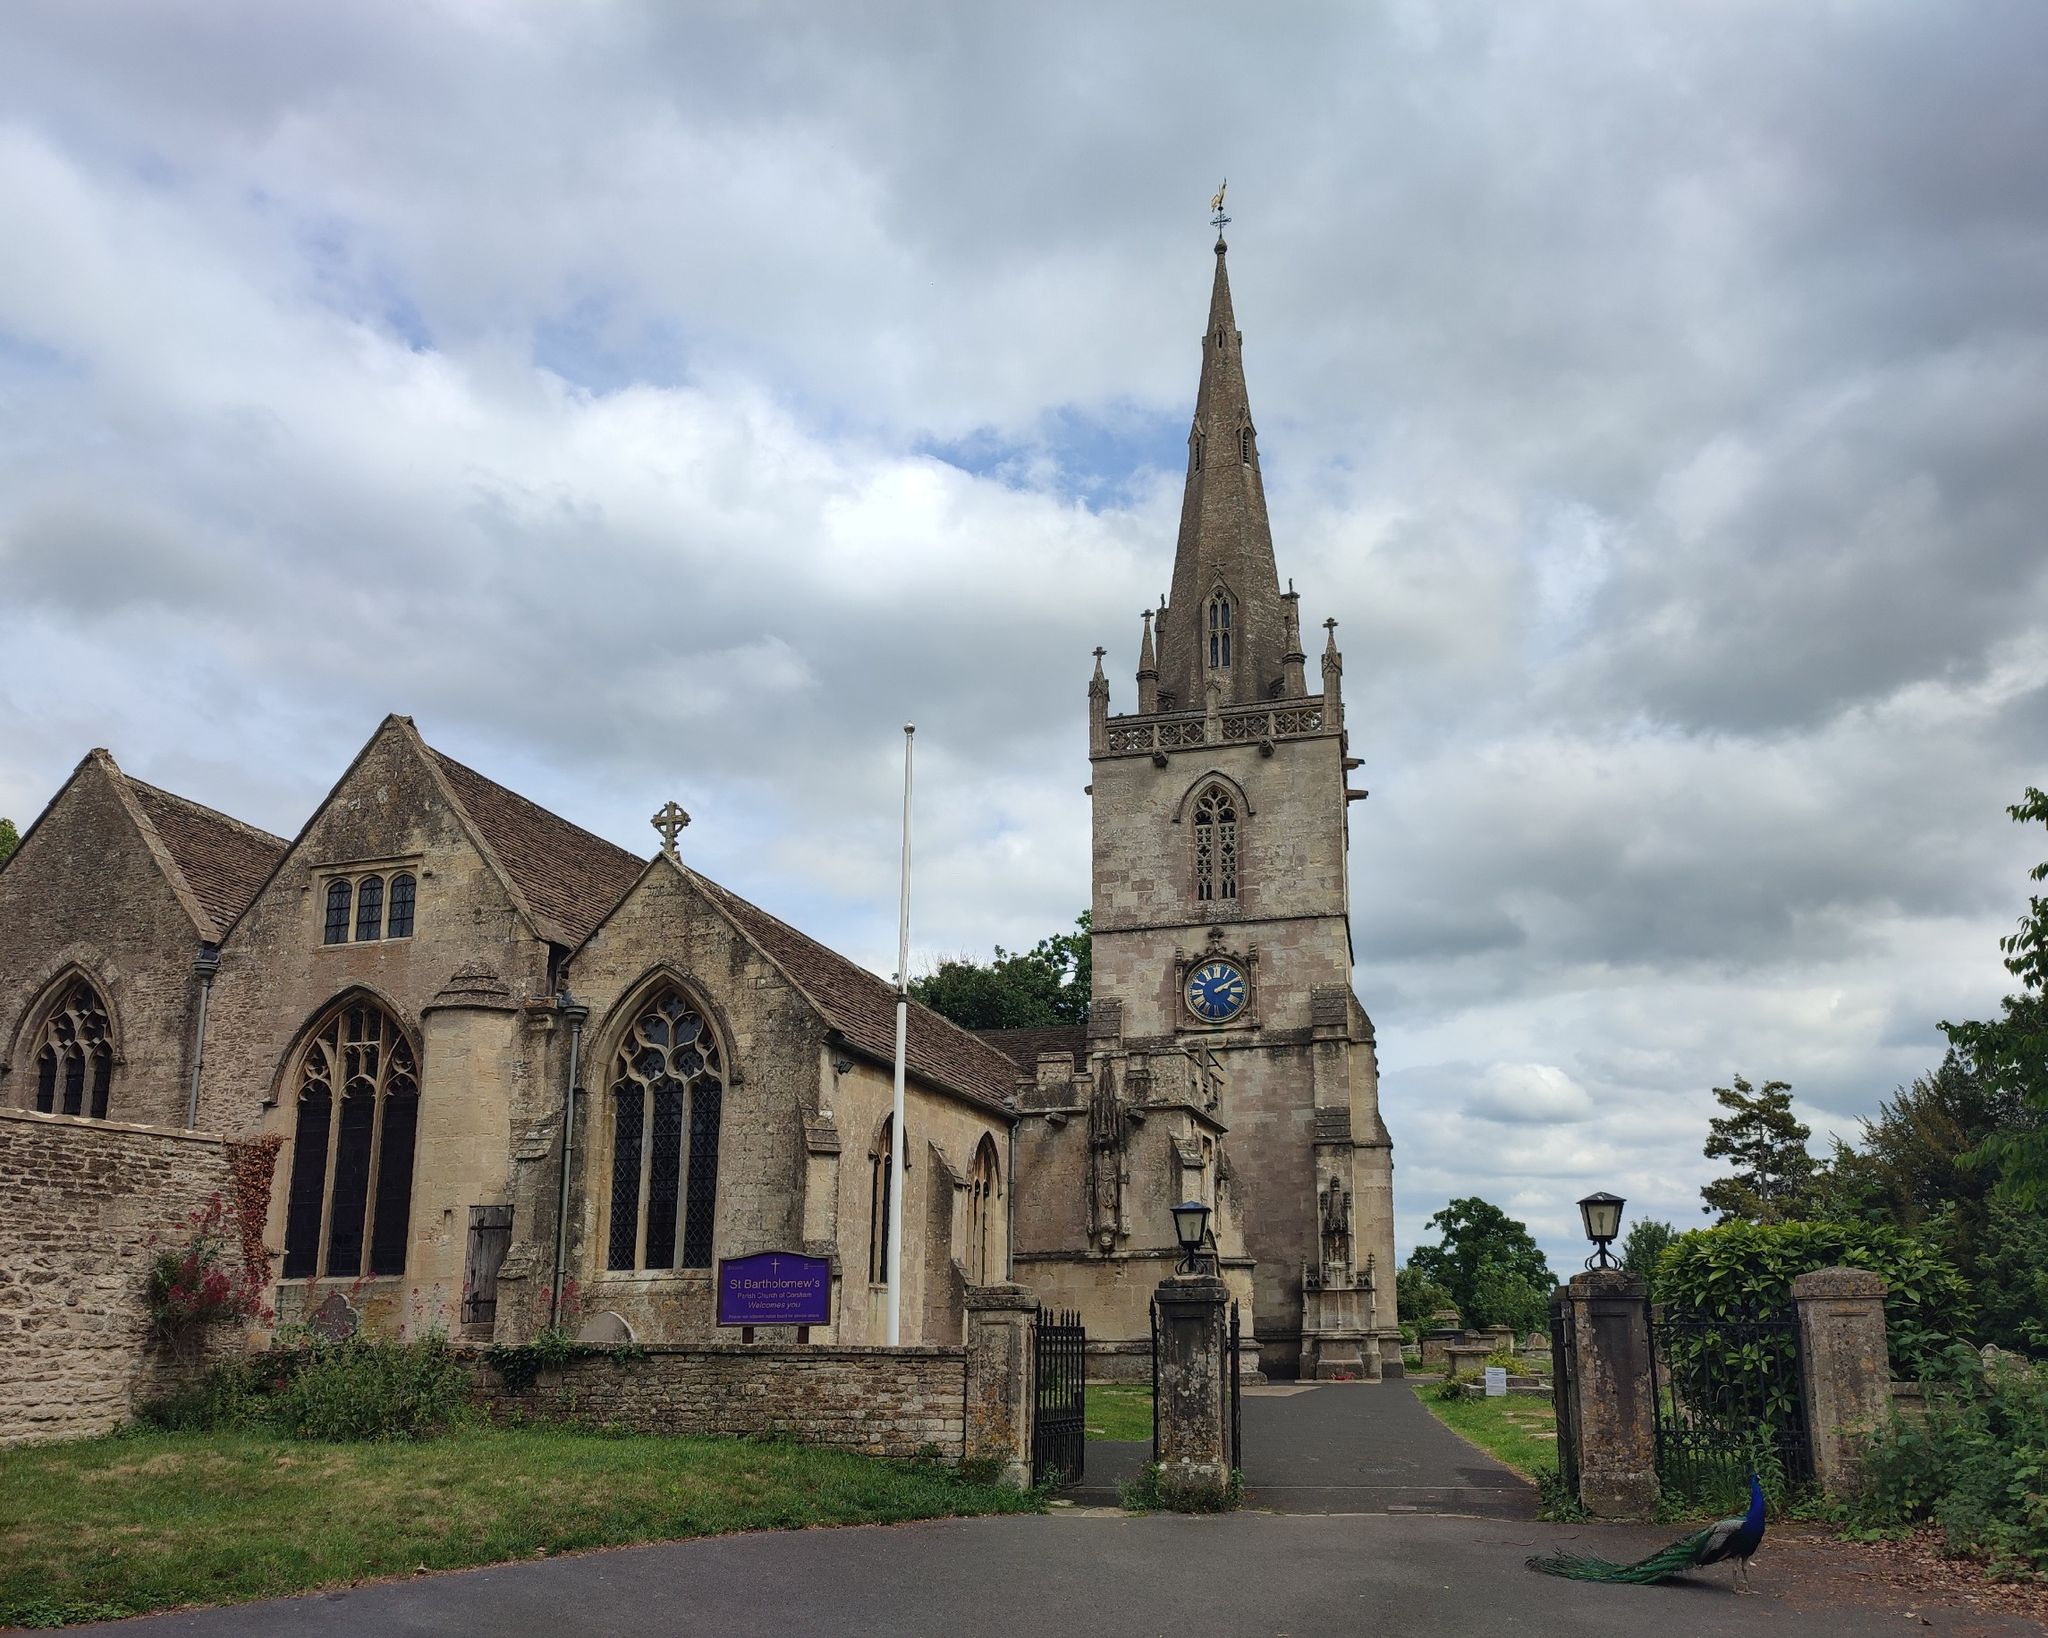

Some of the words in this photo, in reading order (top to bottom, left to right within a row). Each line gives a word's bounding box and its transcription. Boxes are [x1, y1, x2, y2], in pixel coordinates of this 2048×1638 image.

[730, 1280, 741, 1289] St
[744, 1278, 820, 1289] Bartholomew's
[748, 1301, 786, 1309] Welcomes
